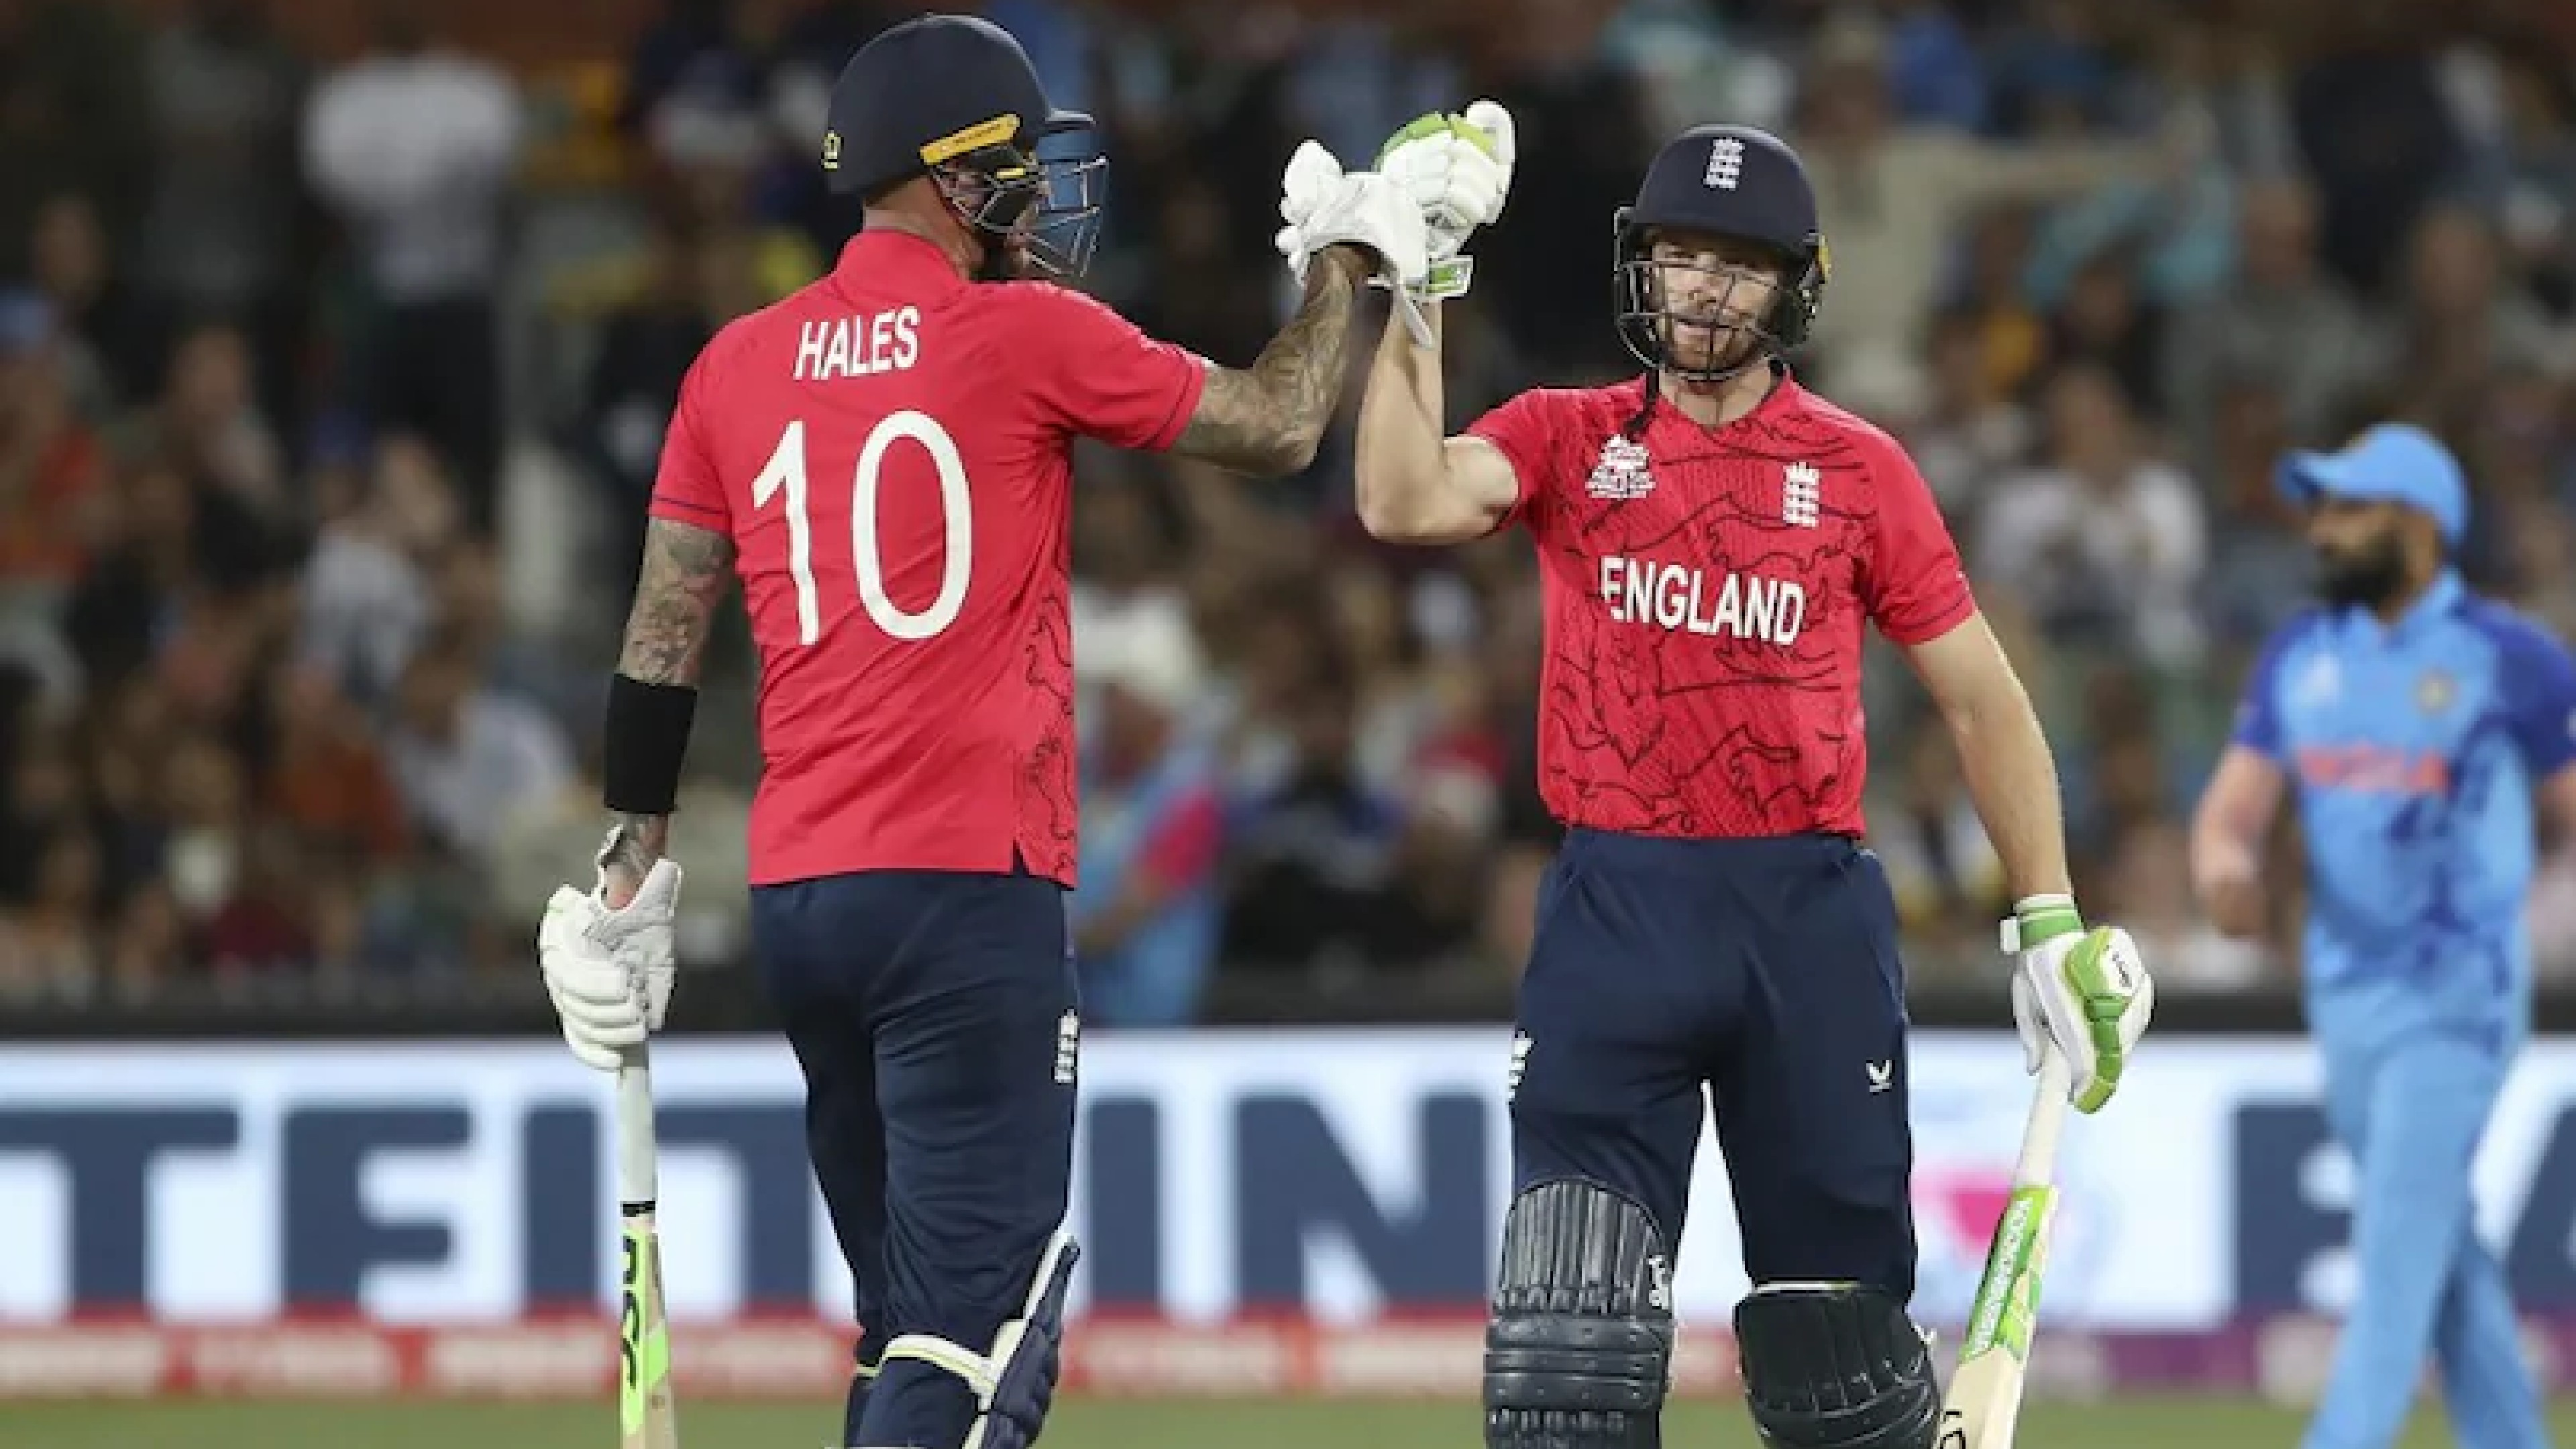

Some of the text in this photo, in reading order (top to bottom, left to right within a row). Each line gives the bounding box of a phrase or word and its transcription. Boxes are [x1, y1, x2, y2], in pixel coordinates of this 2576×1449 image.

[794, 306, 920, 380] HALES
[751, 409, 972, 645] 10
[1601, 557, 1806, 645] ENGLAND
